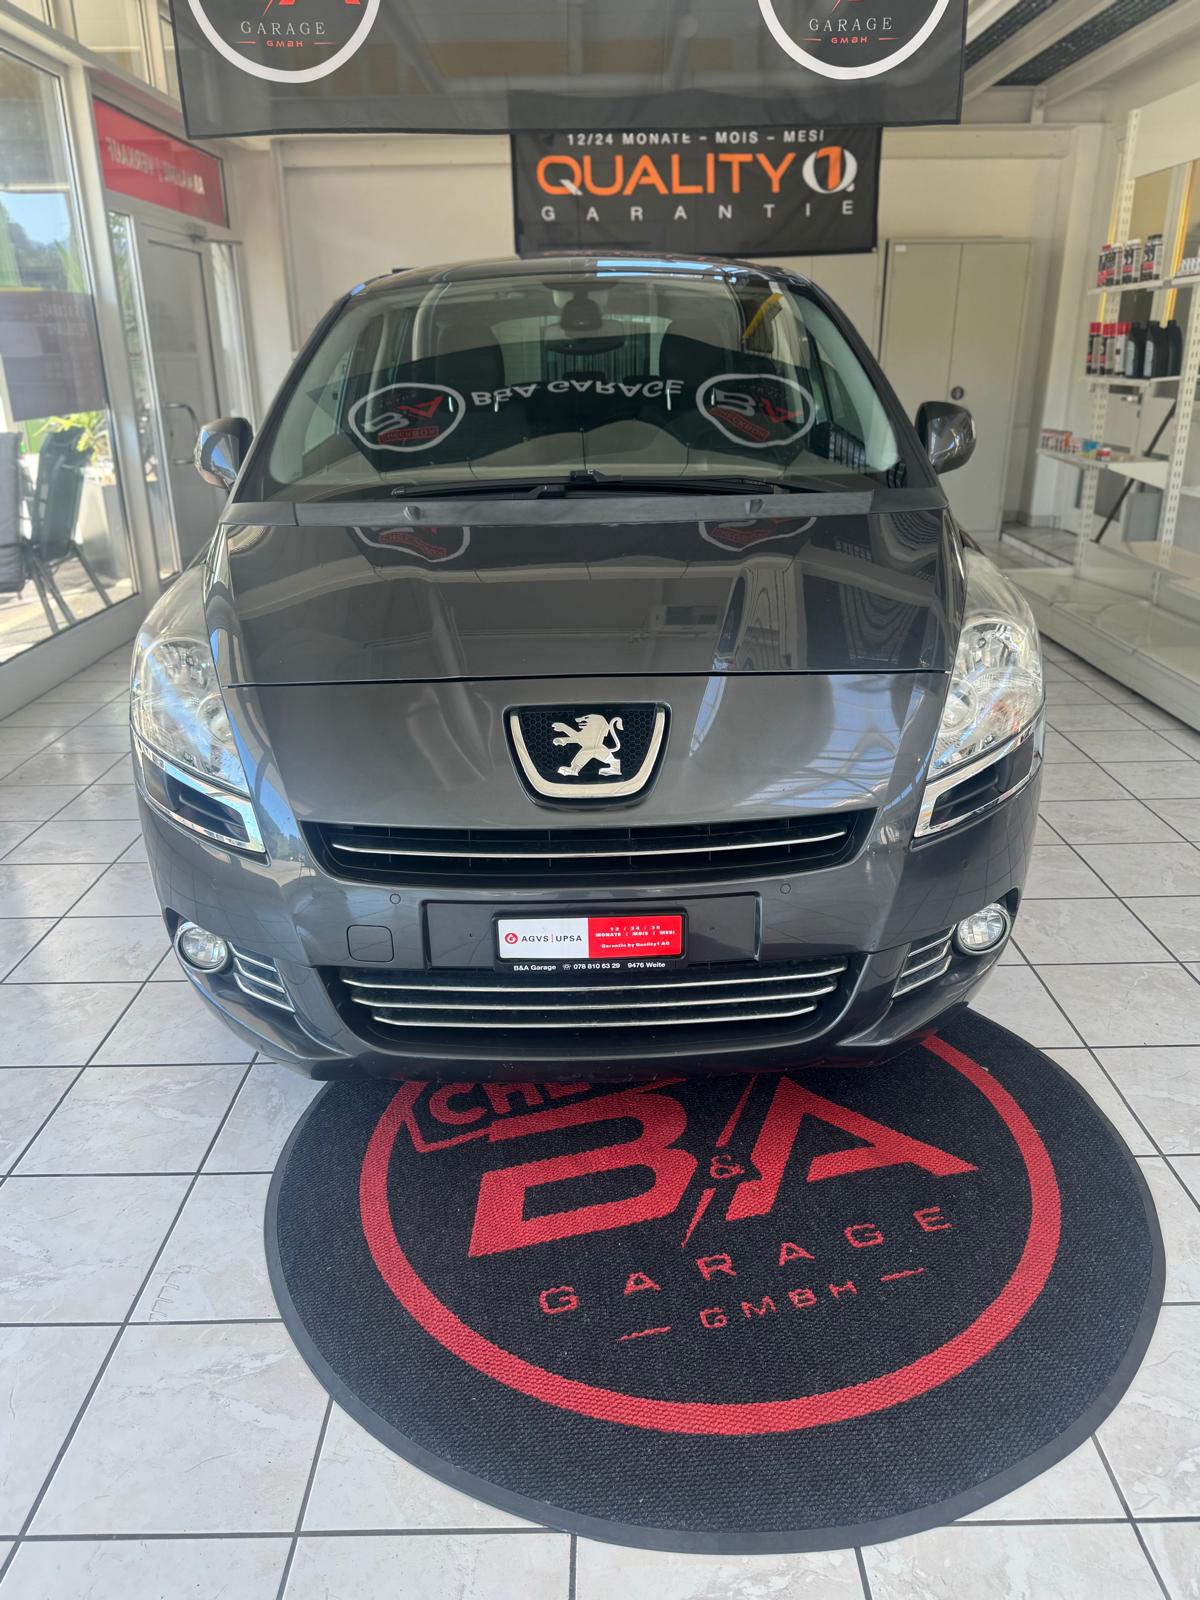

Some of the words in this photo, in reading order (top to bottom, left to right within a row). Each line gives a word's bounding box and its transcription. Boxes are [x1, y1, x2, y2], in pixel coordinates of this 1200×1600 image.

[240, 20, 326, 36] GARAGE
[808, 17, 893, 32] GARAGE
[266, 40, 304, 48] GMBH
[831, 36, 868, 45] GMBH
[566, 133, 614, 147] 12/24
[622, 132, 691, 145] MONATE
[715, 131, 759, 144] MOIS
[783, 129, 825, 143] MESI
[536, 152, 796, 196] QUALITY
[541, 200, 854, 222] GARANTIE
[538, 1205, 953, 1316] GARAGE
[699, 1280, 859, 1329] GMBH
